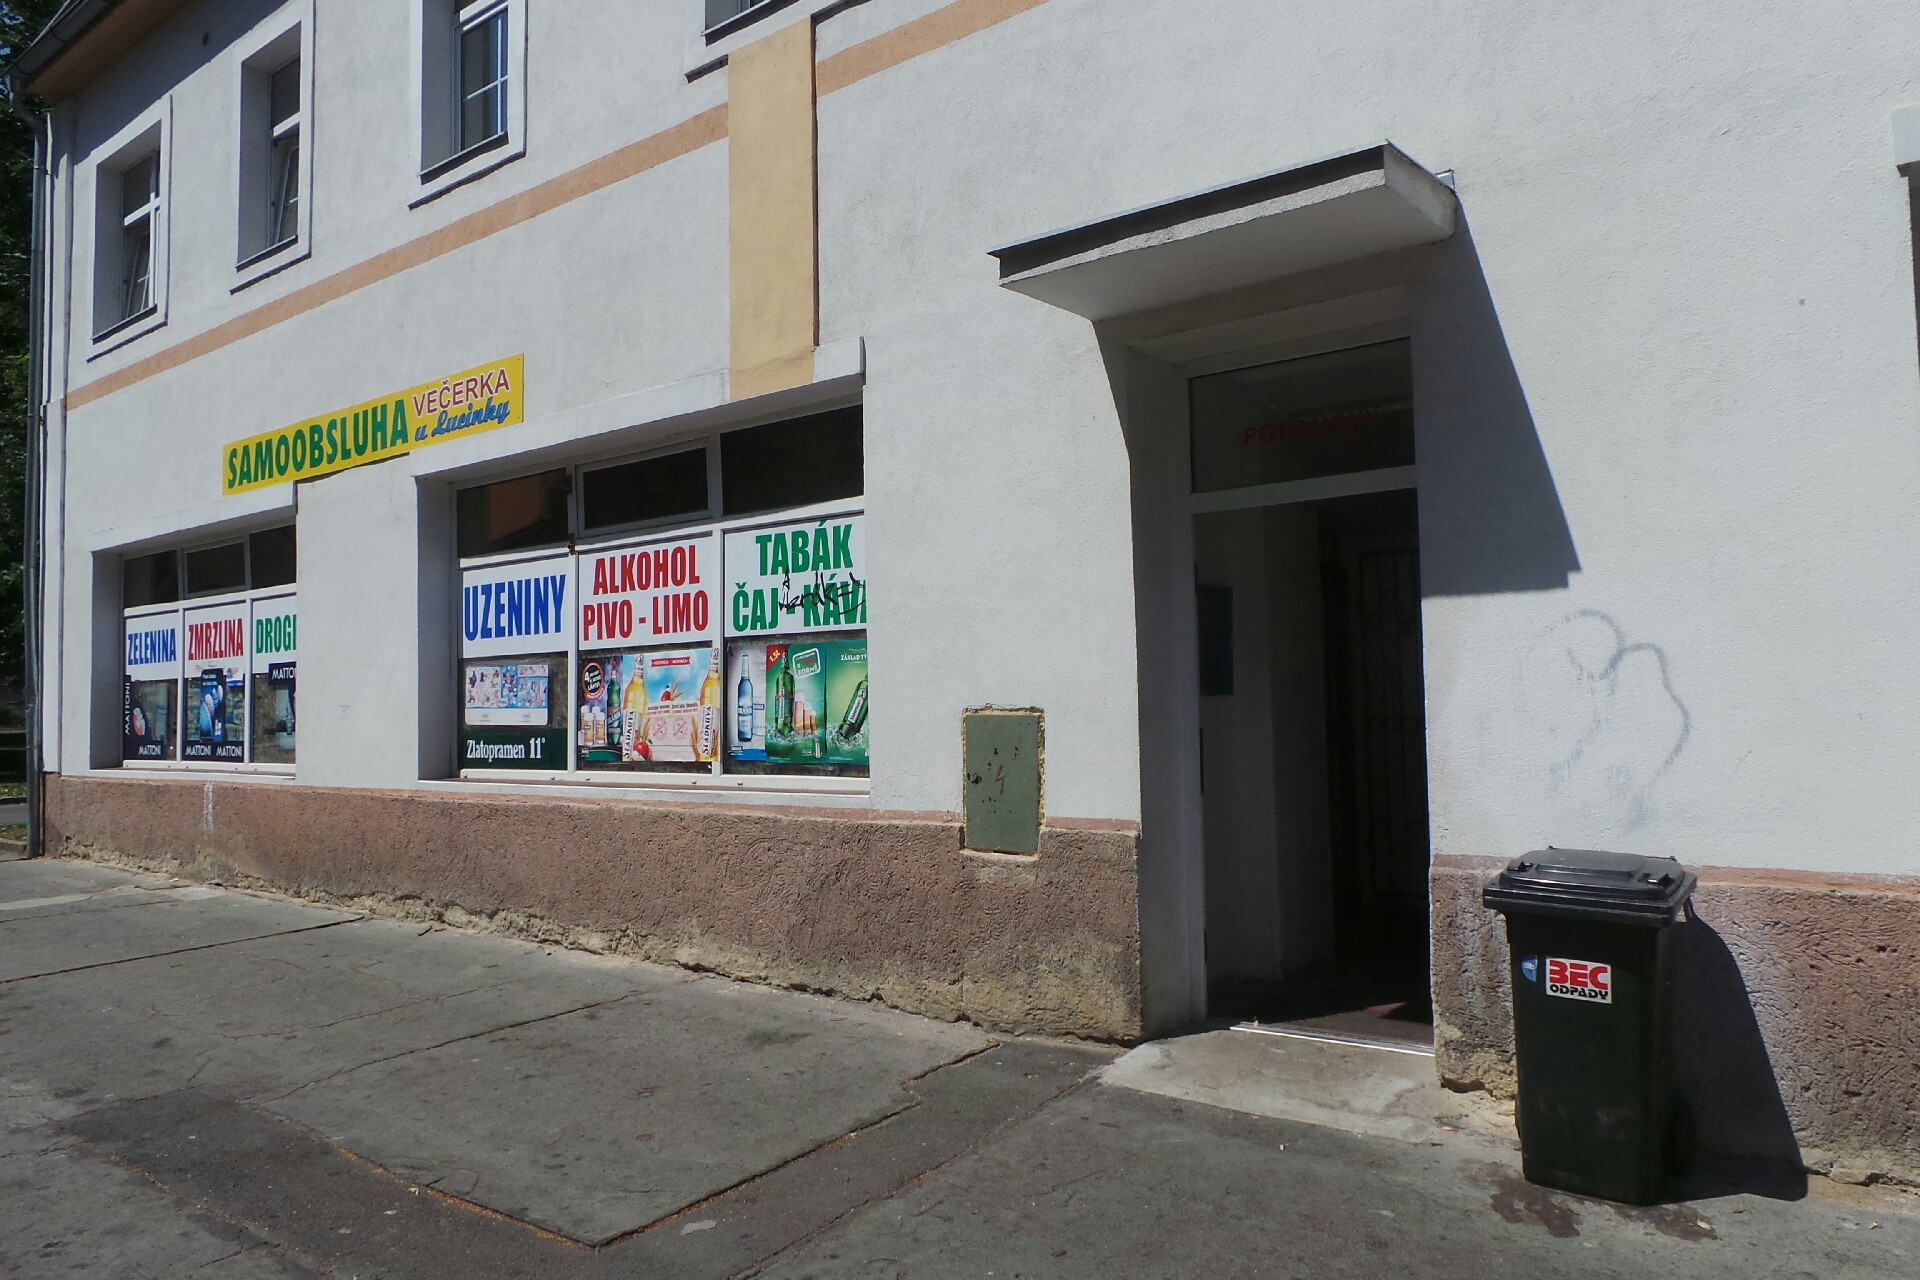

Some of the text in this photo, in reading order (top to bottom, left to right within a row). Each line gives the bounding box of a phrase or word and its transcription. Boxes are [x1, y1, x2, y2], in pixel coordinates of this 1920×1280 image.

[413, 368, 510, 417] VEČERKA
[431, 396, 511, 436] Lucinky
[228, 399, 409, 489] SAMOOBSLUHA
[755, 519, 854, 577] TABÁK
[593, 544, 700, 596] ALKOHOL
[464, 574, 566, 642] UZENINY
[583, 599, 633, 641] PIVO
[652, 590, 709, 636] LIMO
[732, 581, 779, 633] ČAJ
[127, 628, 177, 666] ZELENINA
[188, 618, 244, 661] ZMRZLINA
[138, 745, 162, 756] MATTONI
[185, 745, 212, 756] MATTONI
[215, 746, 243, 758] MATTONI
[466, 739, 526, 763] Zlatopramen
[1549, 984, 1609, 1000] ODPADY
